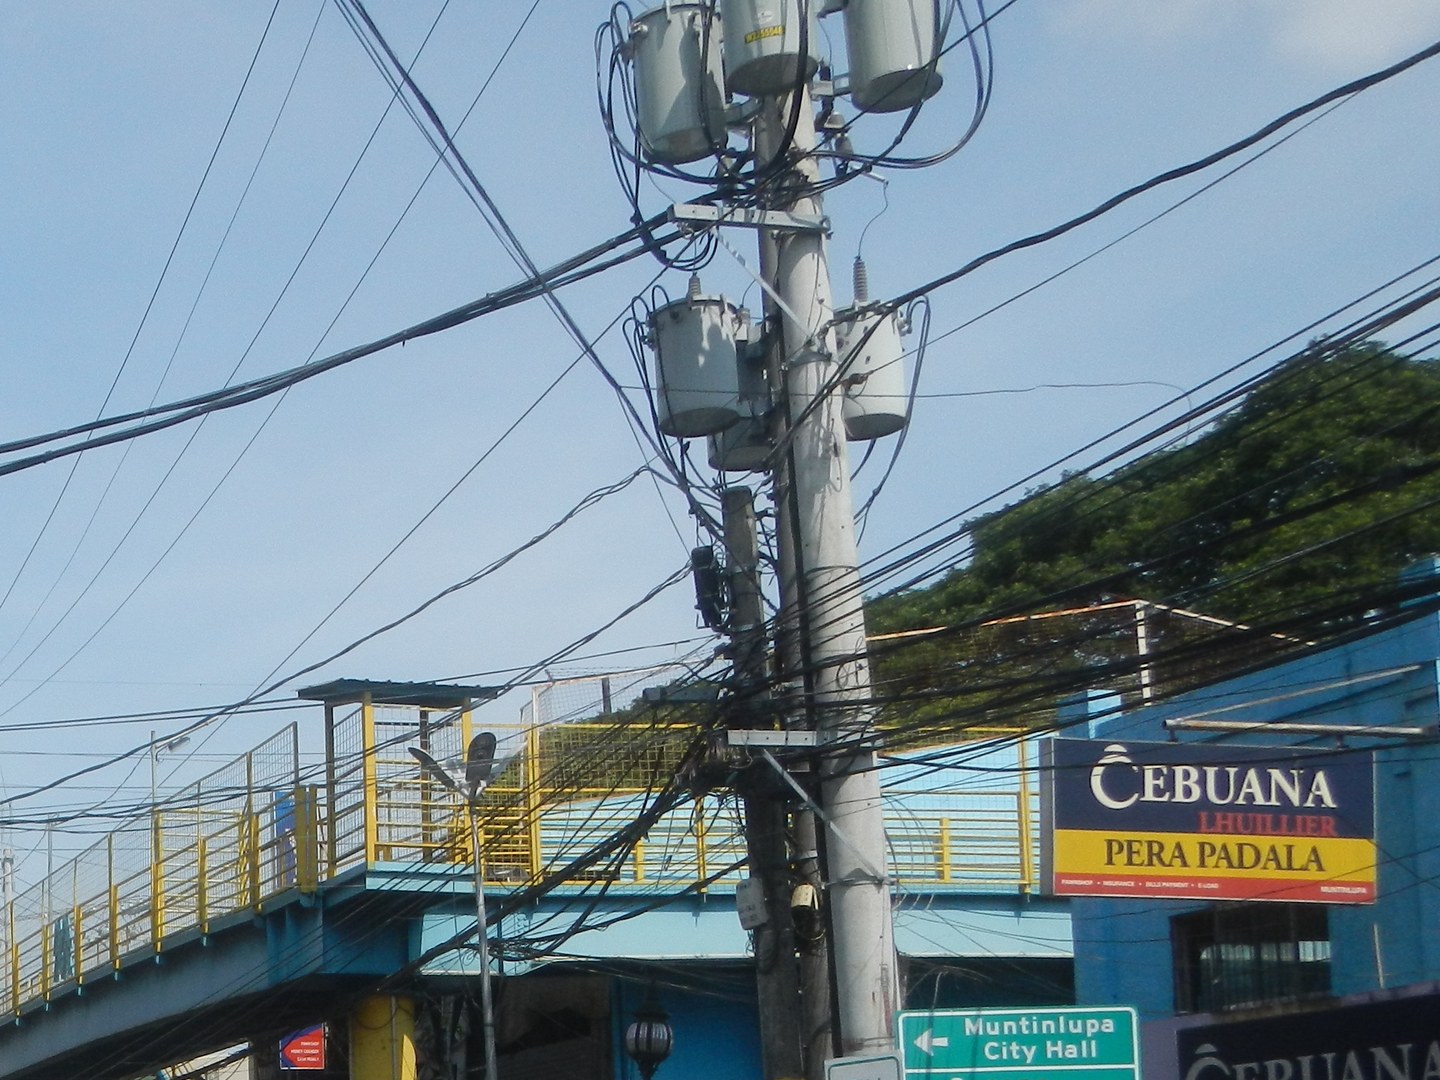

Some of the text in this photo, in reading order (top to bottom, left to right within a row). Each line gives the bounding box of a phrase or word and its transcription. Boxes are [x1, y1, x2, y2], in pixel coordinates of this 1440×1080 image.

[1199, 811, 1338, 837] LHUILLIER
[1105, 838, 1326, 873] PERA PADALA
[964, 1016, 1115, 1038] Muntinlupa
[984, 1039, 1097, 1063] City Hall
